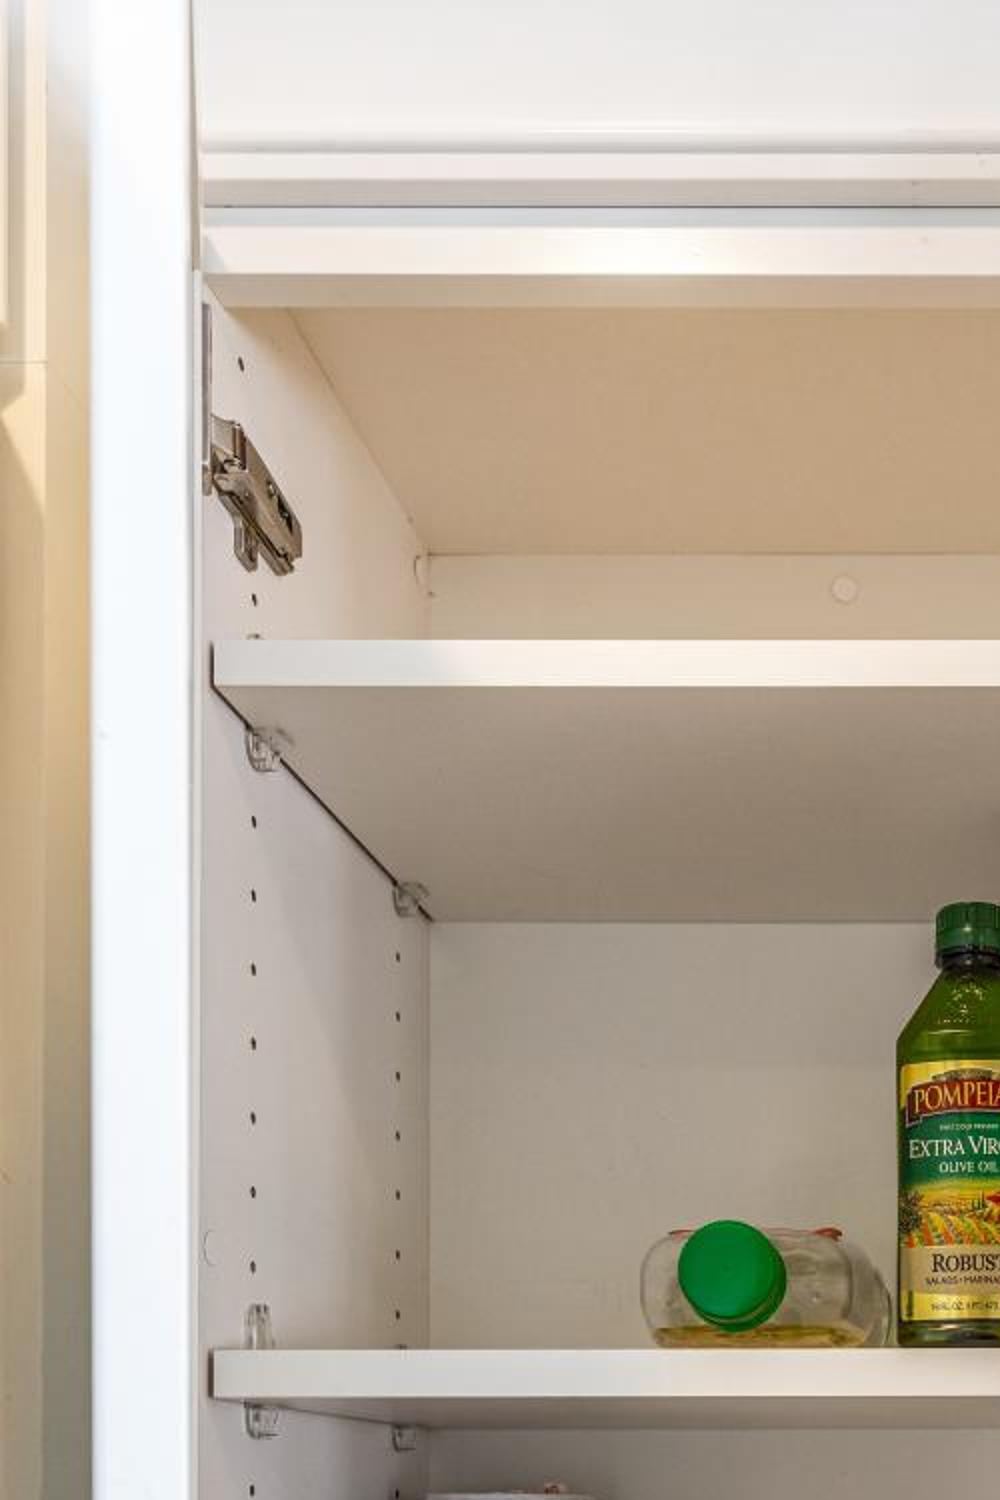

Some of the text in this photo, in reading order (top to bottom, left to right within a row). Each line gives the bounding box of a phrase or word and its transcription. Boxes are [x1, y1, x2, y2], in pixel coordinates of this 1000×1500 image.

[909, 1138, 965, 1159] EXTRA
[939, 1161, 999, 1174] OLIVE OIL
